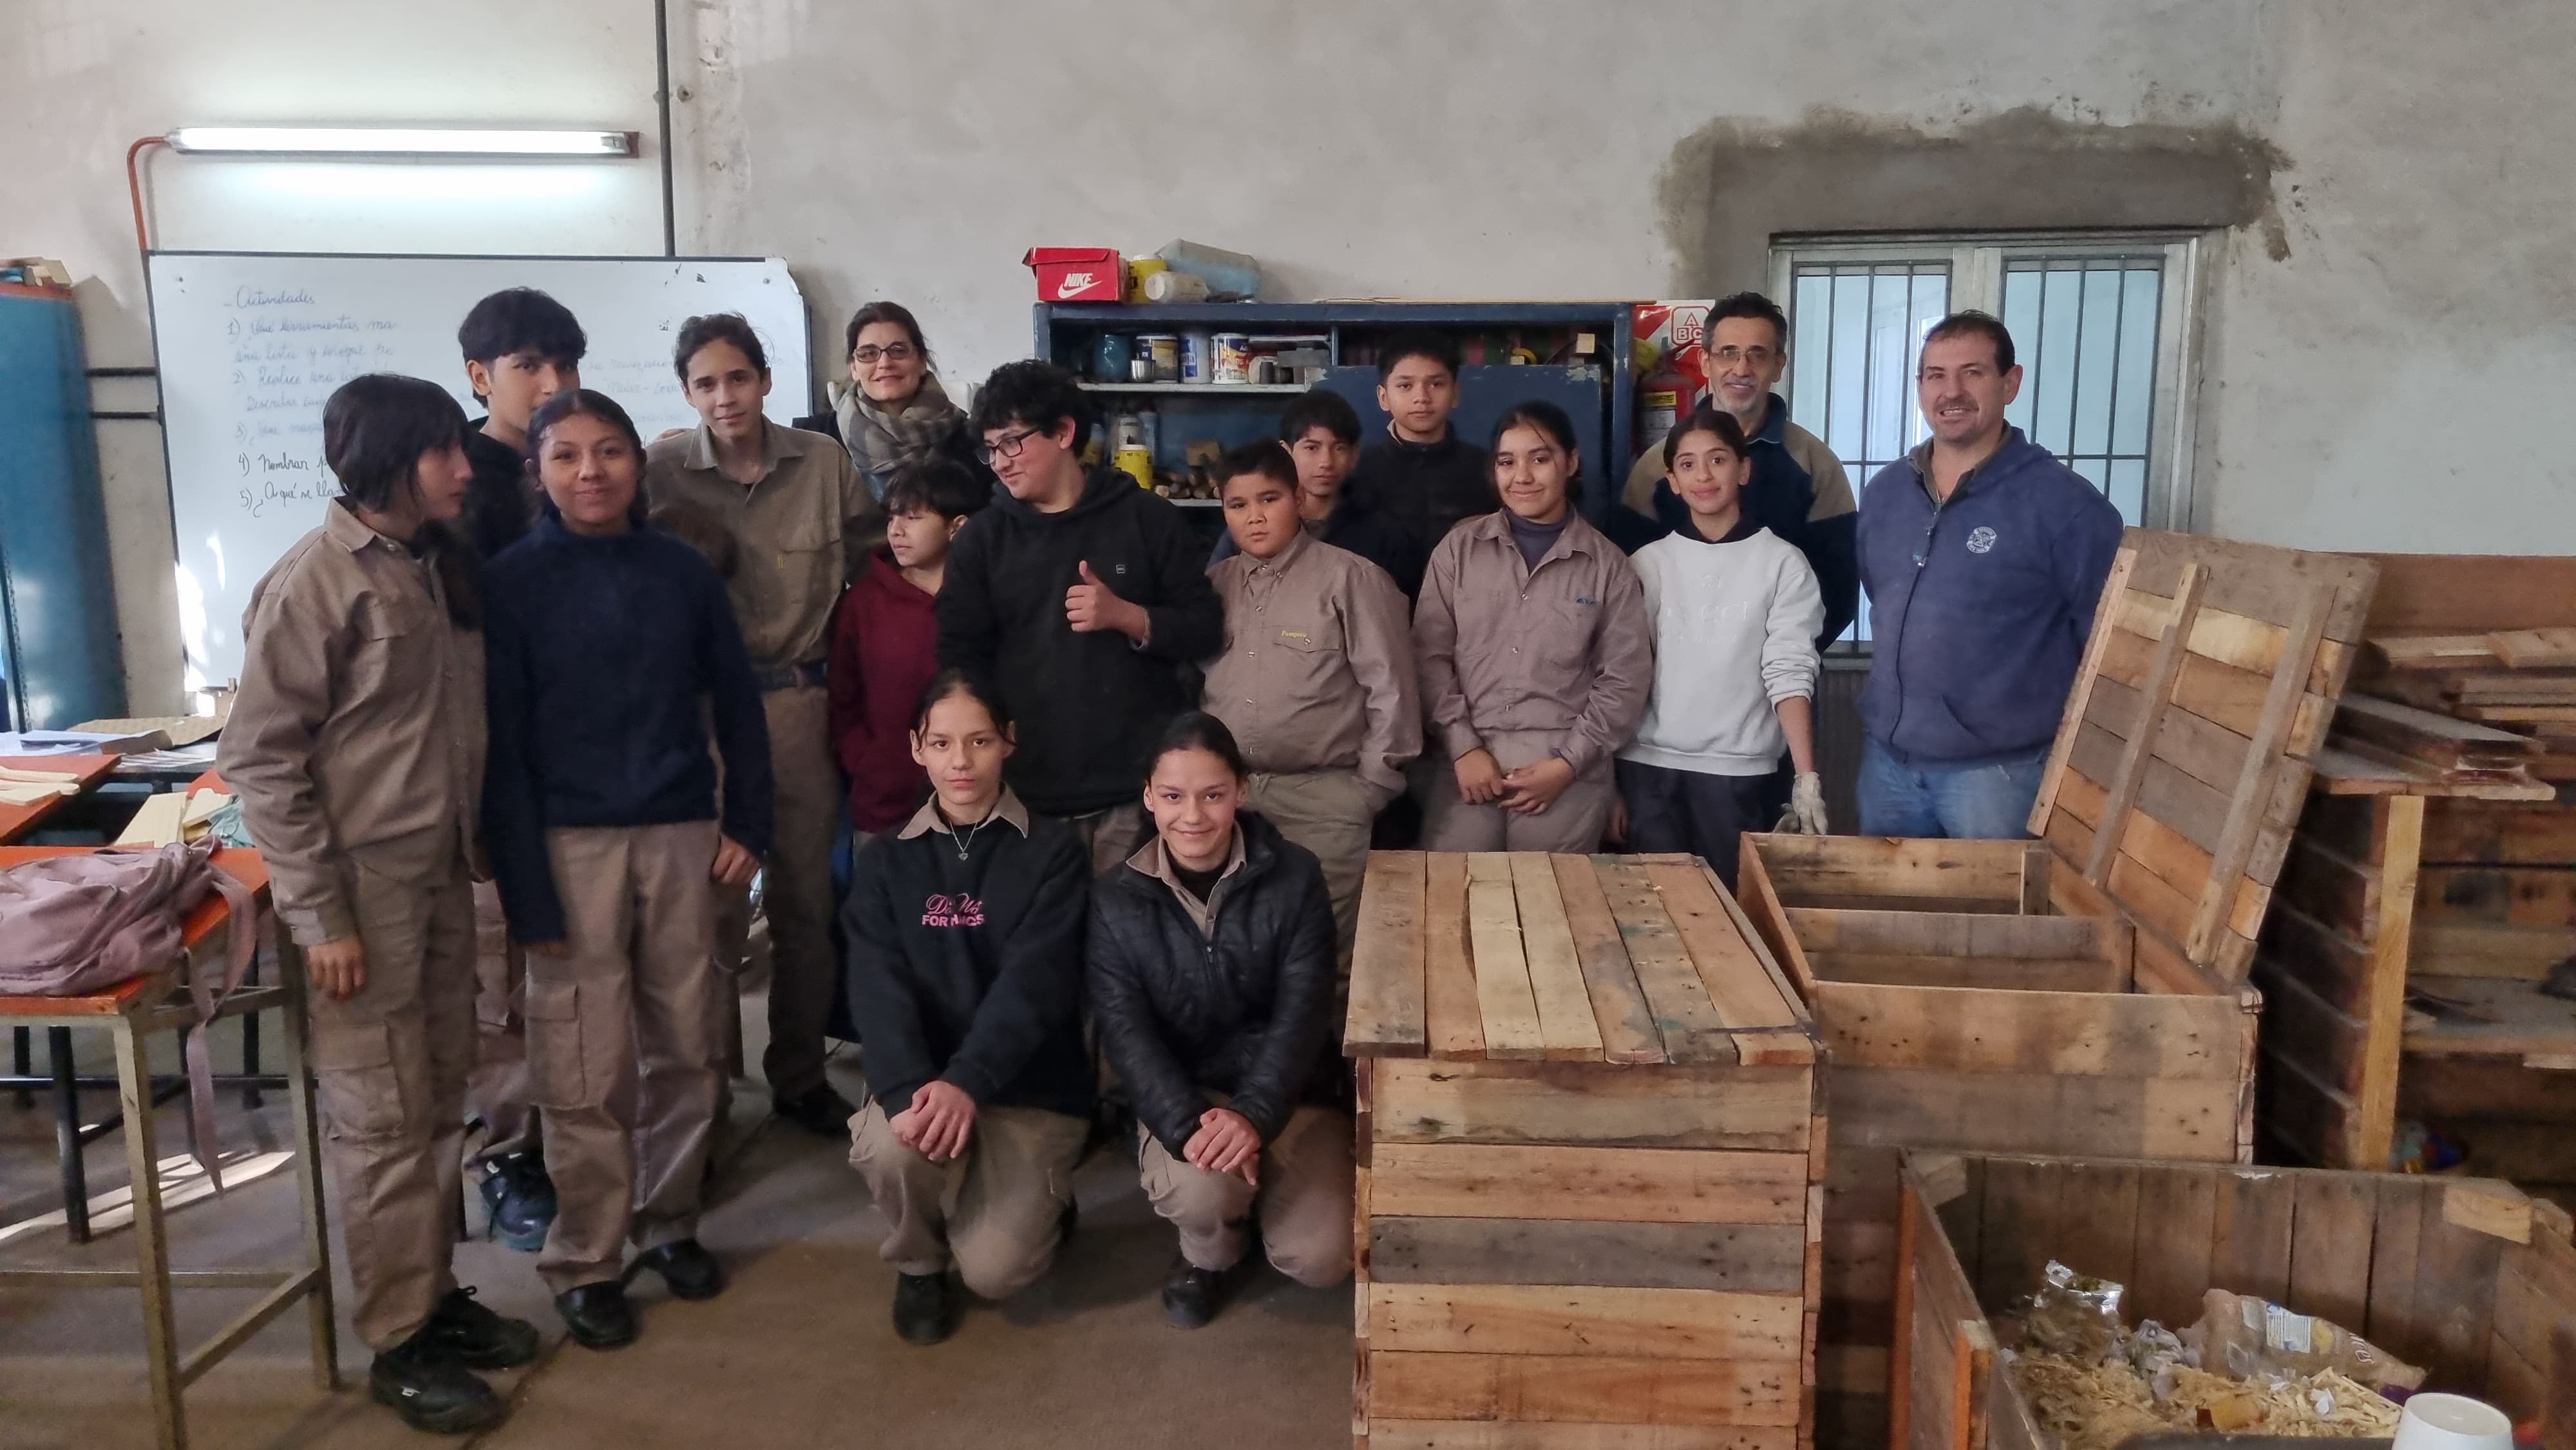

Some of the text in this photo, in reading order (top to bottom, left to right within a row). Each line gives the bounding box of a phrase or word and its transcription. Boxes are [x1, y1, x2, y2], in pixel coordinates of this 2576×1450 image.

[1064, 273, 1093, 287] NIKE
[1678, 329, 1687, 339] B
[238, 453, 250, 477] 4)
[240, 487, 252, 510] 5)
[316, 480, 341, 496] lla
[922, 915, 949, 927] FOR
